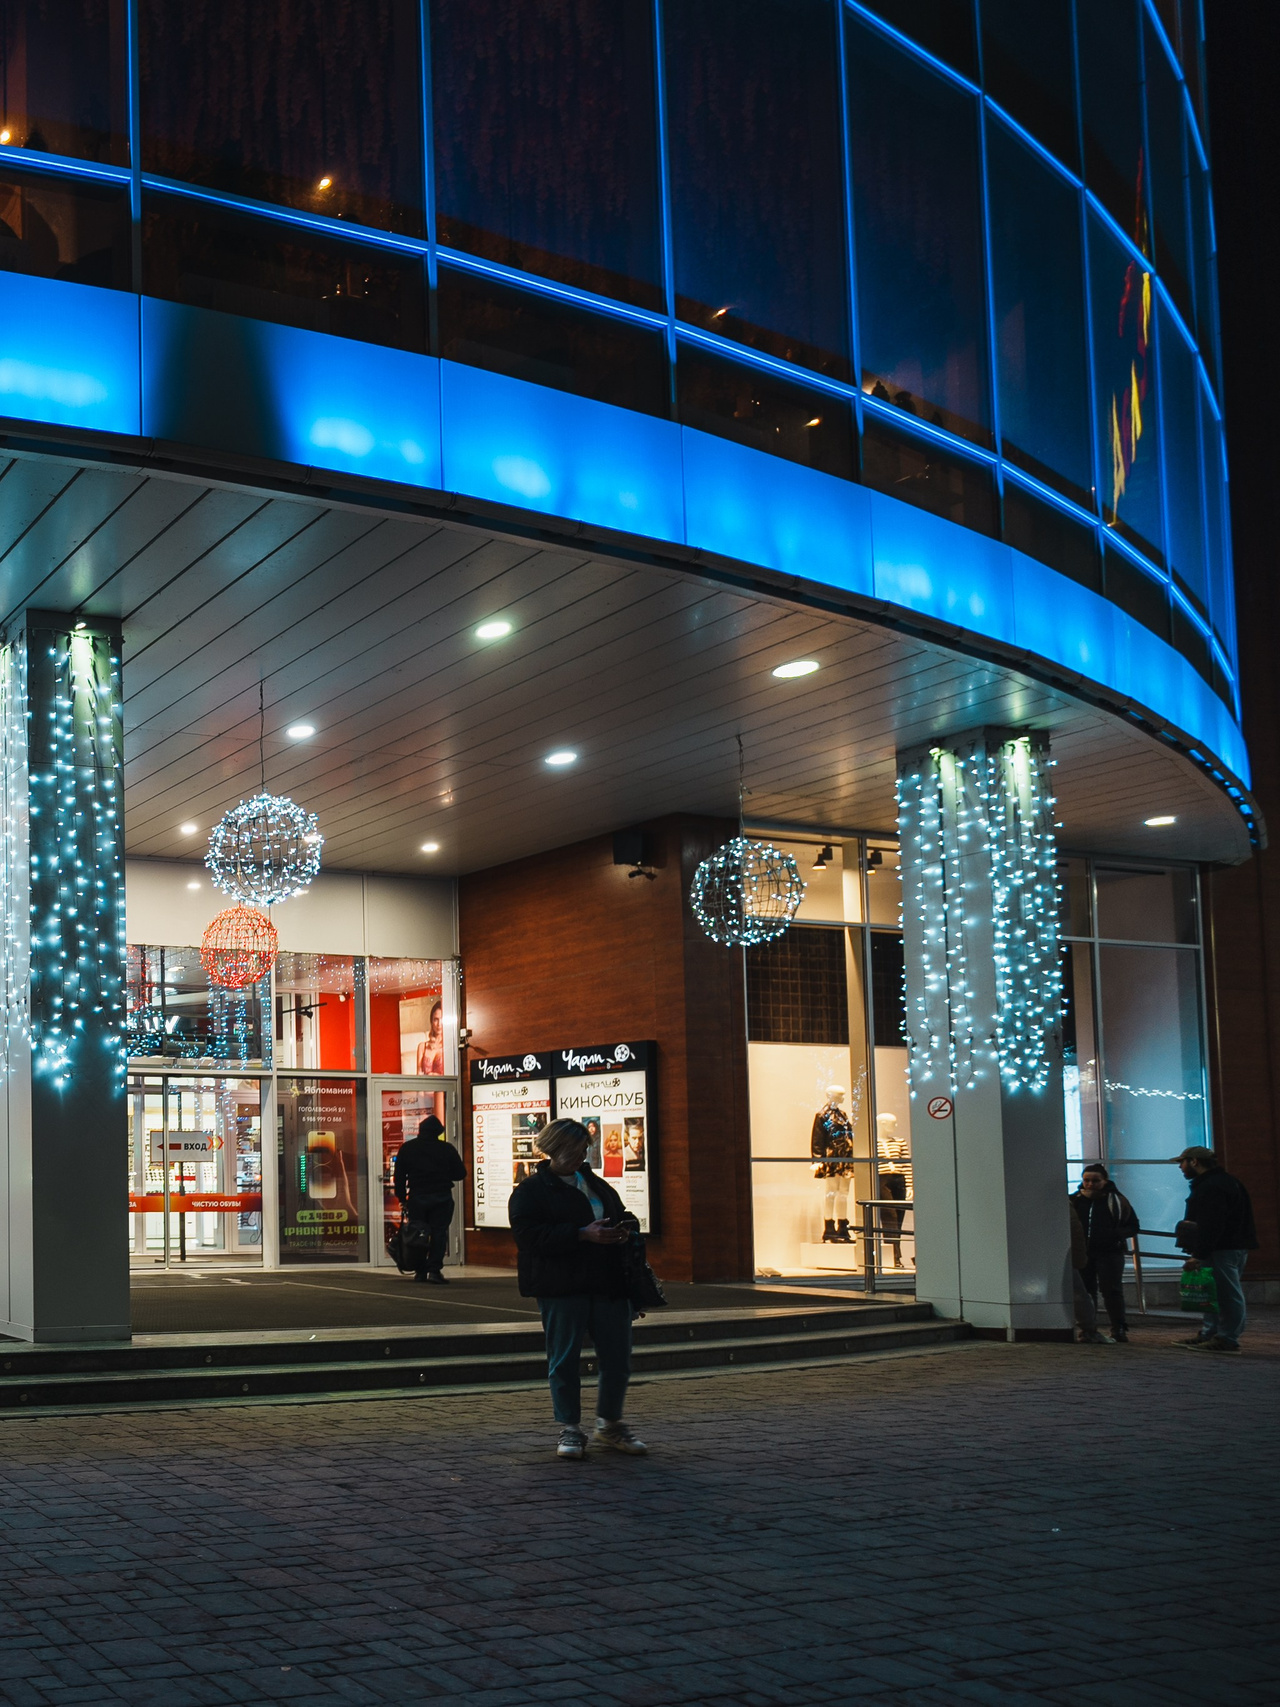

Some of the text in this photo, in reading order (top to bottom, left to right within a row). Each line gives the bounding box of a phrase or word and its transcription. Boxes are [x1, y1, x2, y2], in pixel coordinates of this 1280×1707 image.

[562, 1048, 605, 1072] Чарли
[478, 1059, 515, 1080] Чарли
[304, 1085, 353, 1095] Ябломания
[560, 1091, 644, 1109] КИНОКЛУБ
[184, 1143, 208, 1151] ВХОД
[476, 1114, 485, 1207] ТЕАТР В КИНО
[284, 1225, 366, 1236] IPHONE 14 PRO
